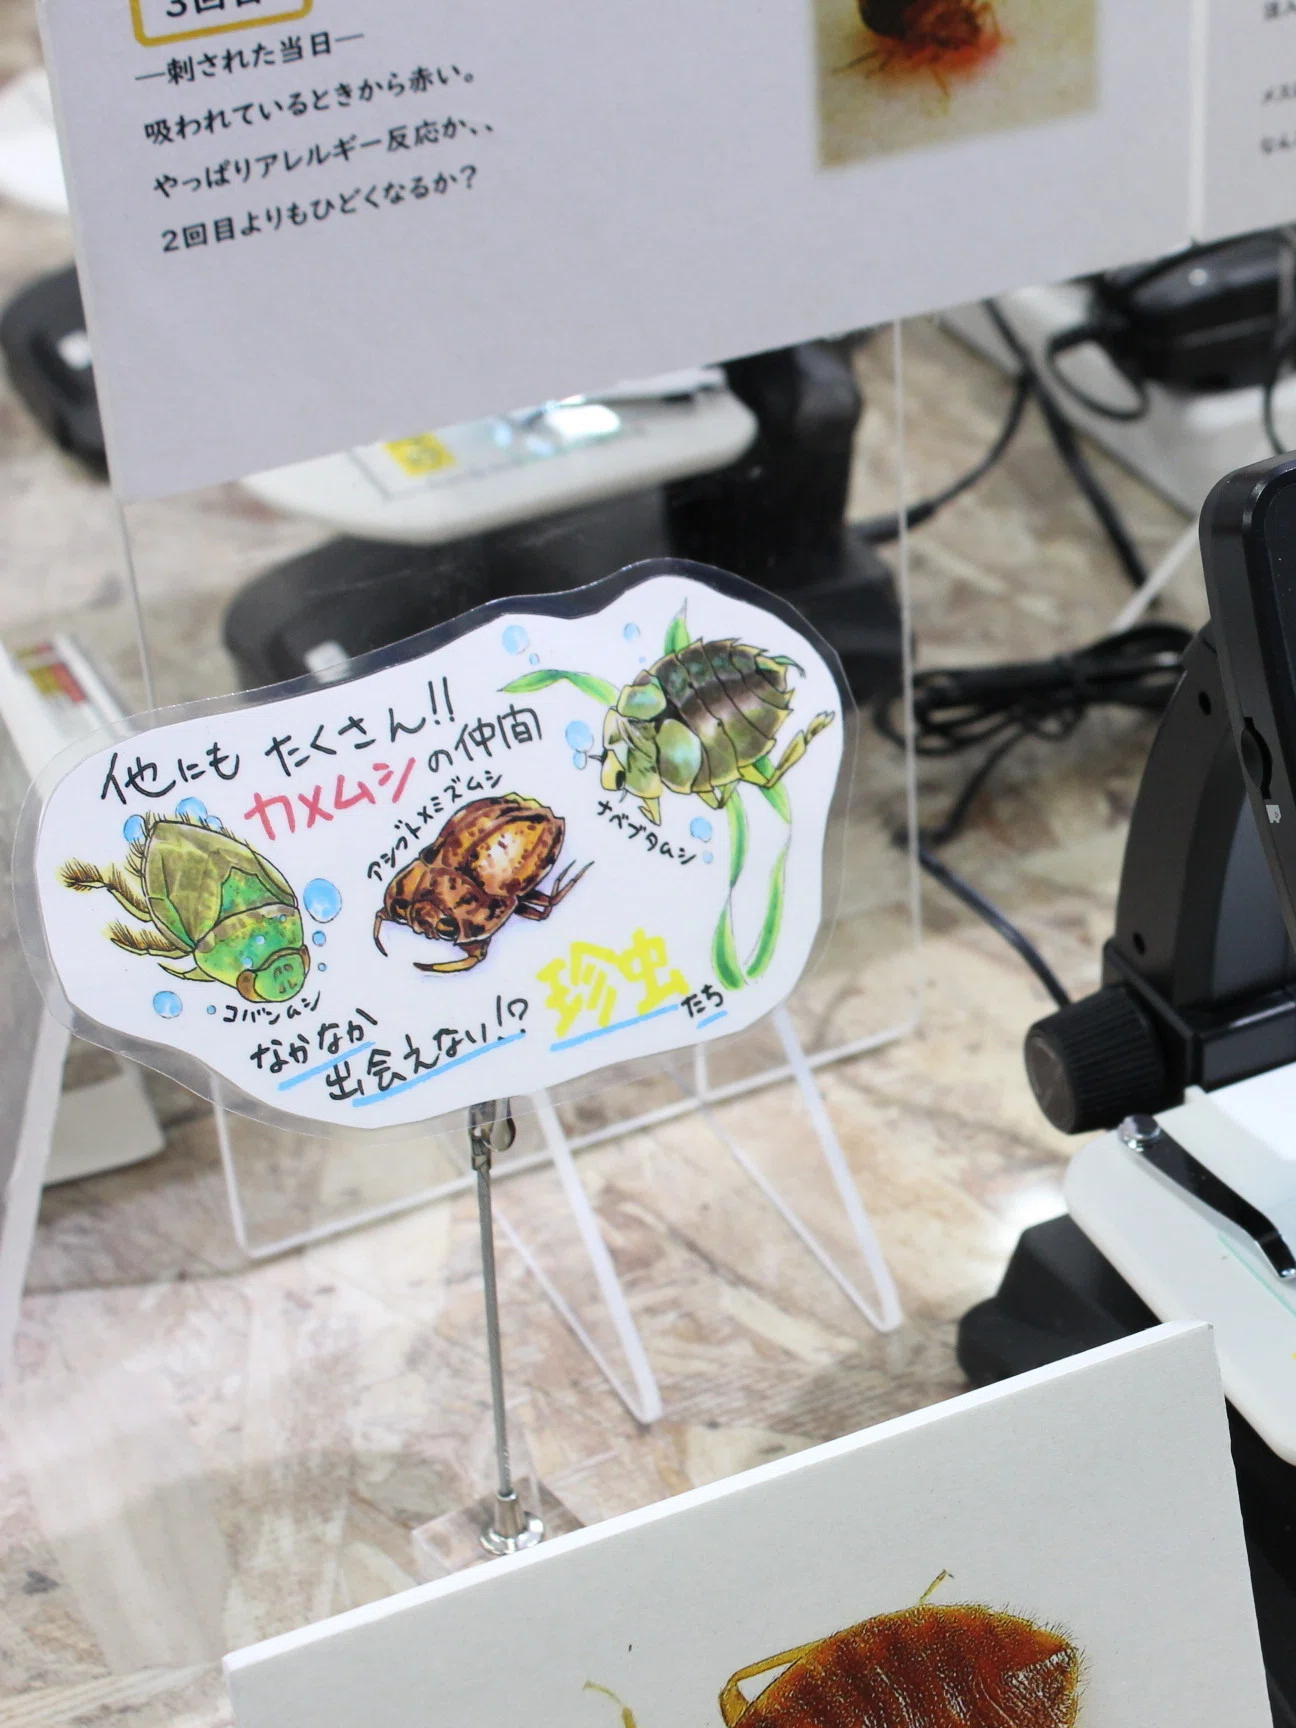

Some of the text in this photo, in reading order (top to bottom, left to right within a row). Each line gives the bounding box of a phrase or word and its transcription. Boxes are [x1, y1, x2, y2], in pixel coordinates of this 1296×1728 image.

[143, 64, 476, 146] 吸われているときから赤い。
[250, 1008, 378, 1074] なかなか
